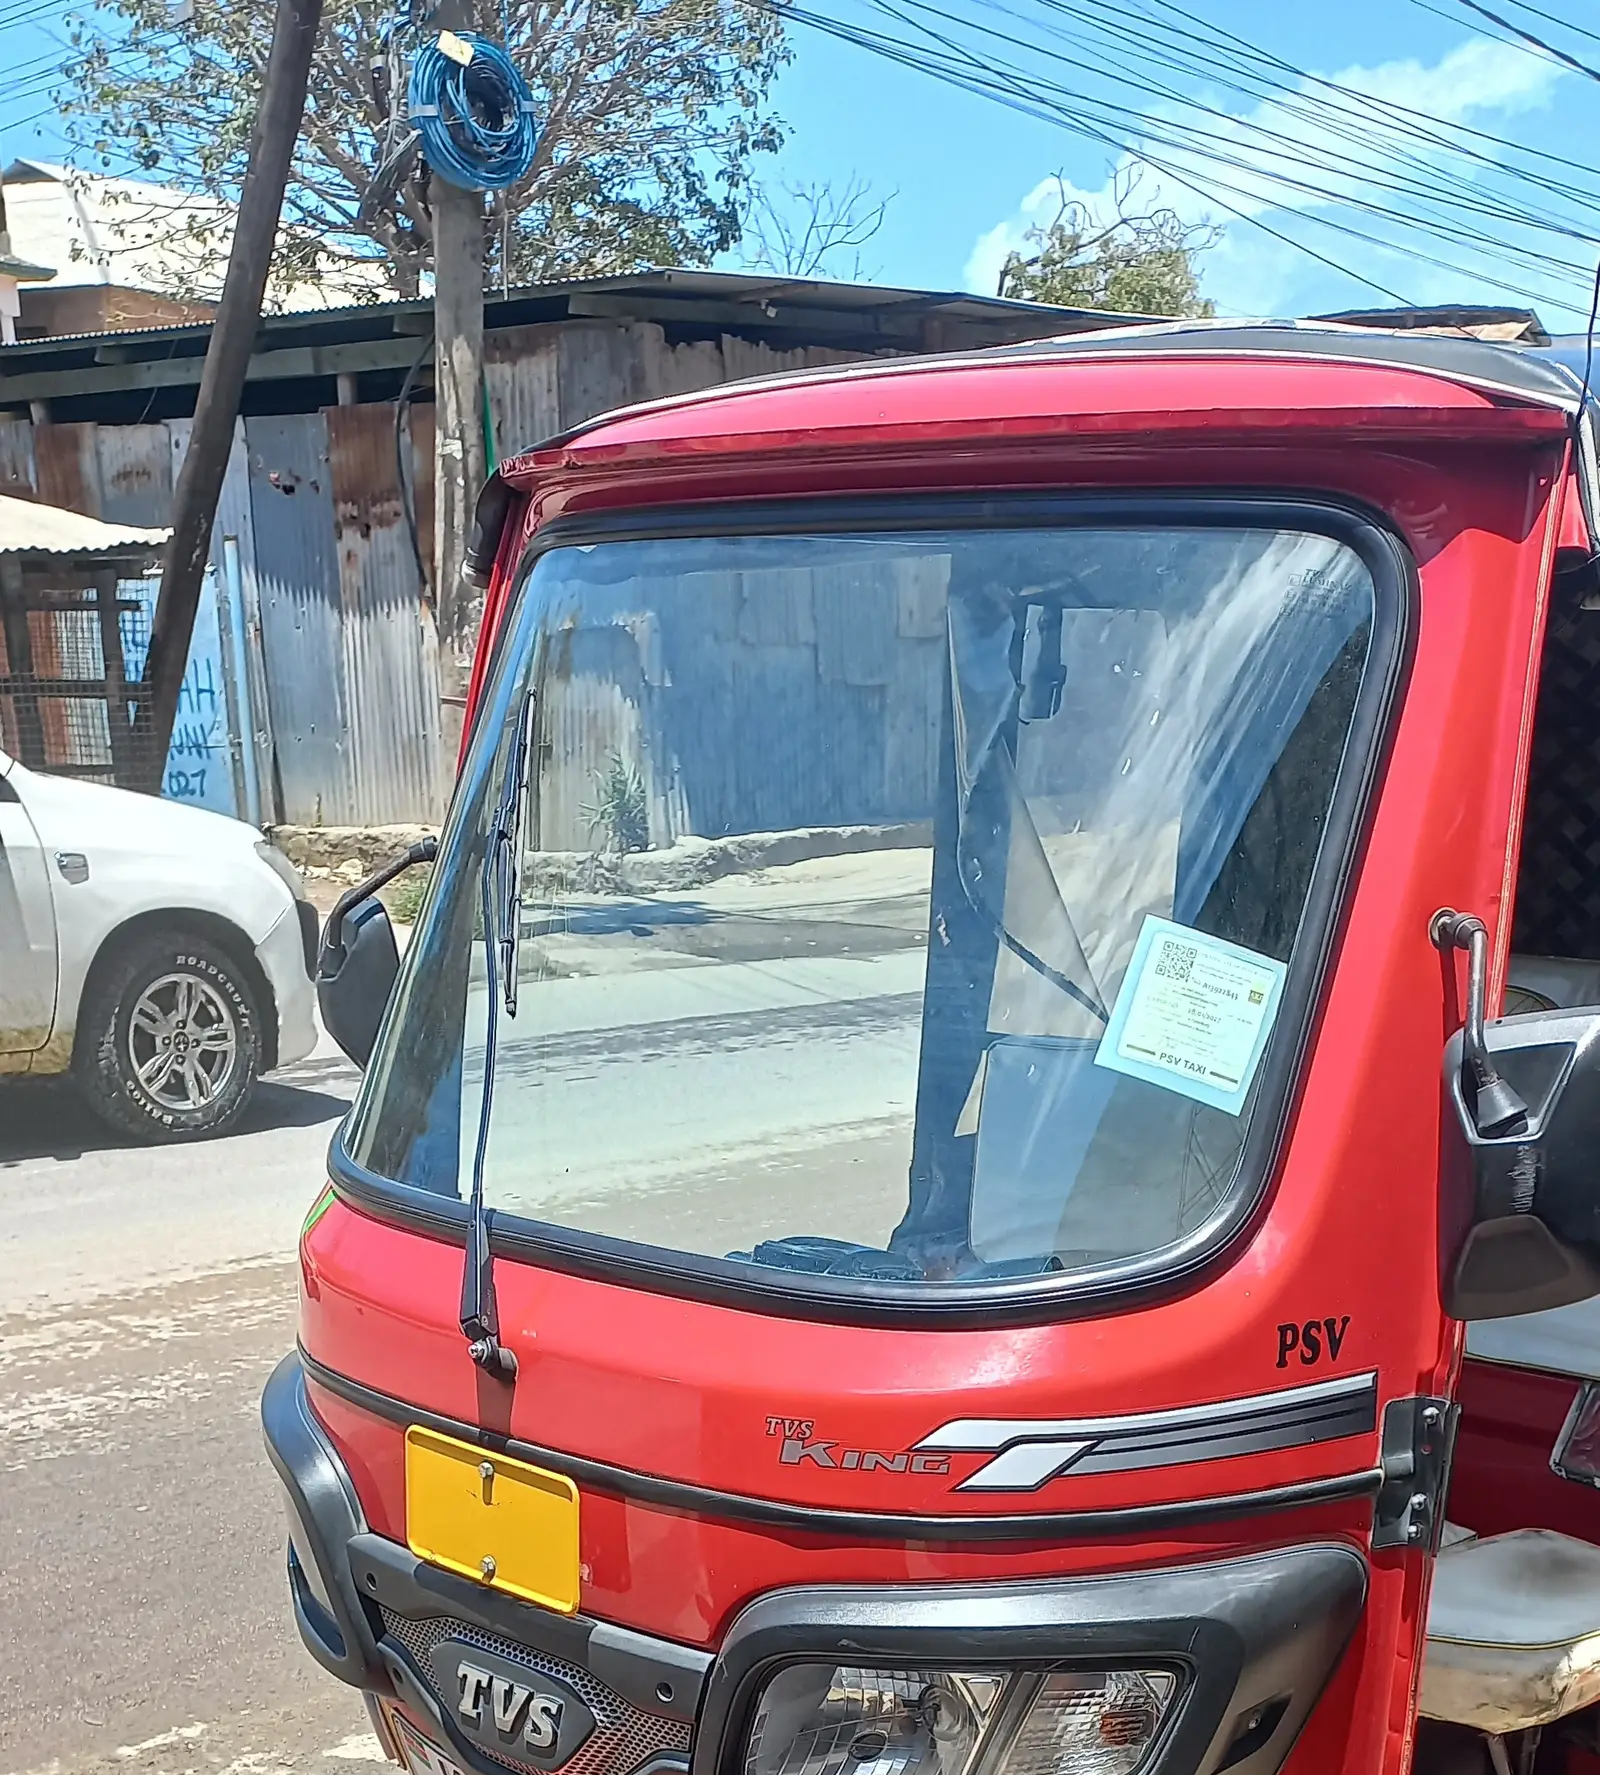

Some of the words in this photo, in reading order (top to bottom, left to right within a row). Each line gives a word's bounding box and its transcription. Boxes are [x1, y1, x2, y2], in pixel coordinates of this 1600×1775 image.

[177, 658, 215, 714] AH
[161, 768, 206, 798] 027
[1159, 1052, 1182, 1066] PSV
[1183, 1059, 1207, 1075] TAXI
[1275, 1315, 1351, 1369] PSV
[765, 1416, 814, 1439] TVS
[455, 1660, 566, 1749] TVS
